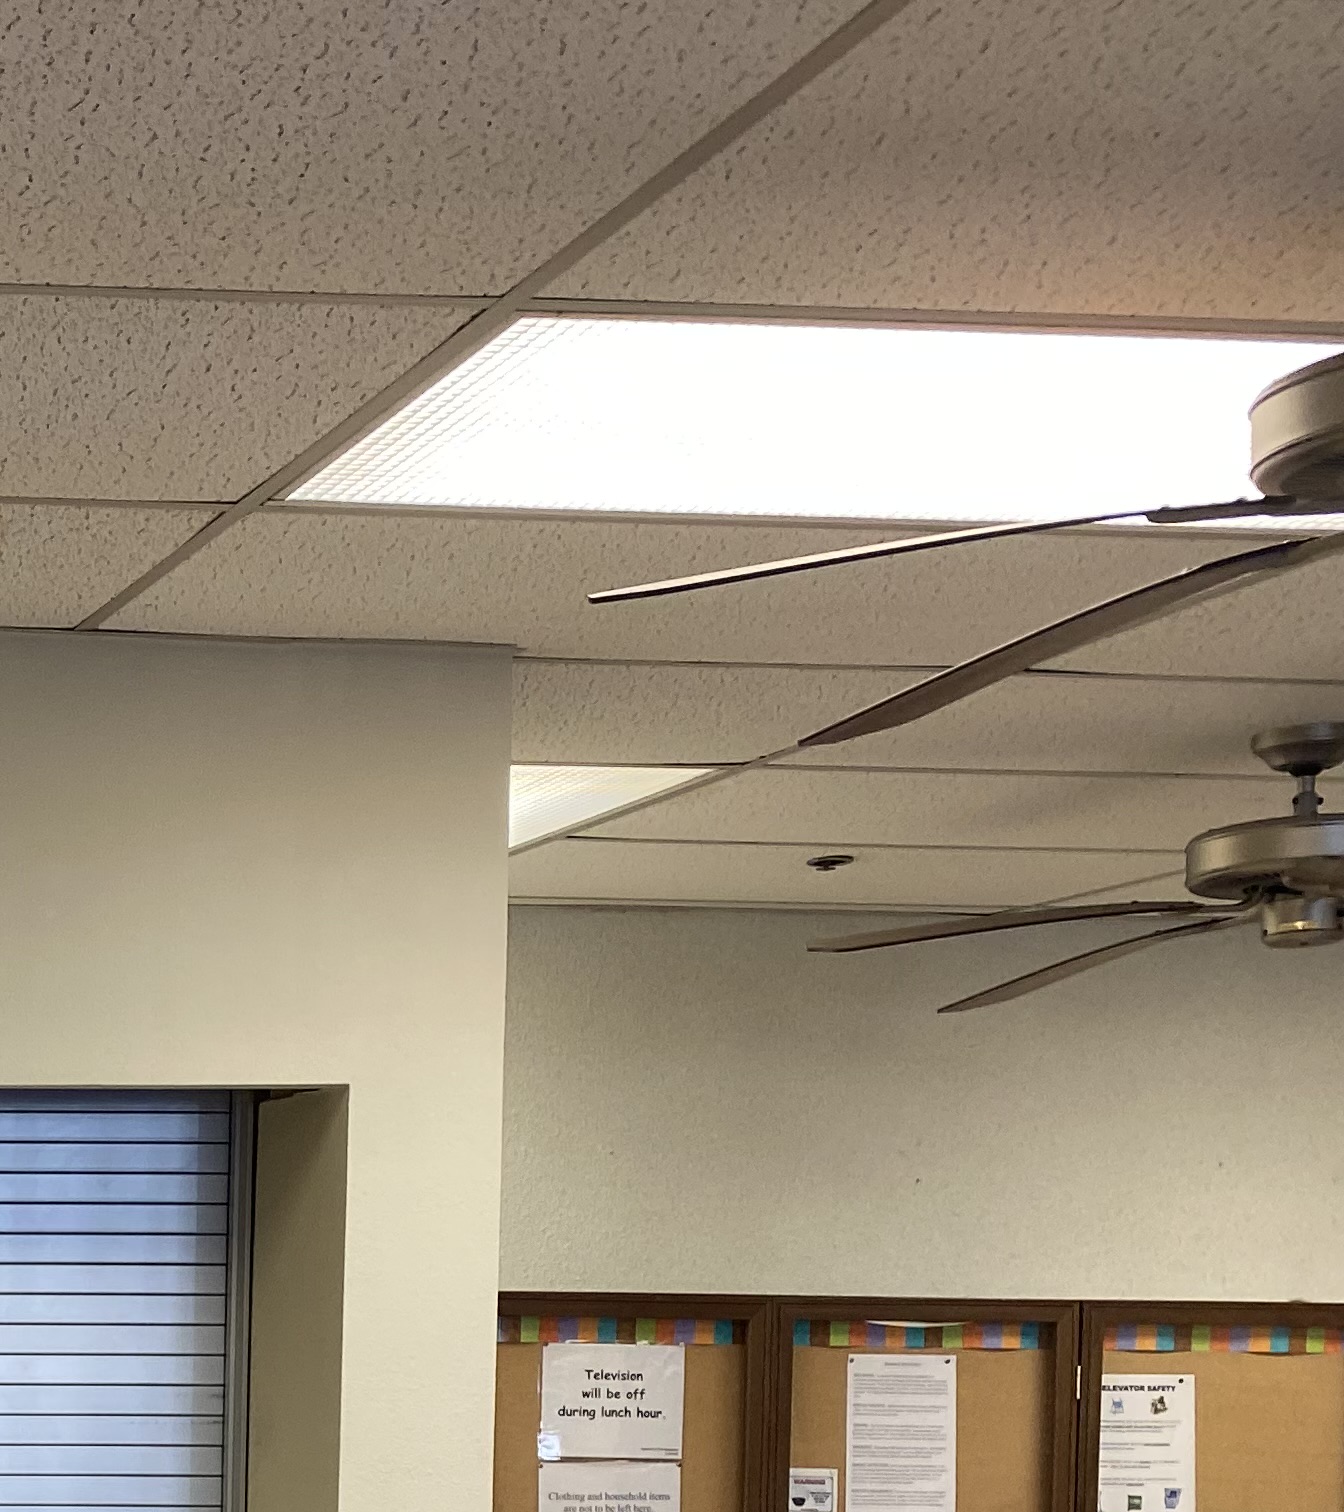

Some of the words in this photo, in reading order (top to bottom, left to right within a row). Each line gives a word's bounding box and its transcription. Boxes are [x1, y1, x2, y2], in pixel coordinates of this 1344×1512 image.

[585, 1369, 643, 1381] Television
[582, 1388, 601, 1398] will
[607, 1388, 620, 1399] be
[627, 1389, 645, 1400] off
[558, 1405, 595, 1420] during
[602, 1406, 631, 1417] lunch
[637, 1407, 666, 1420] hour.
[548, 1492, 585, 1502] Clothing
[587, 1492, 602, 1500] and
[605, 1492, 647, 1500] household
[649, 1492, 670, 1500] items
[605, 1504, 615, 1512] be
[618, 1504, 631, 1512] left
